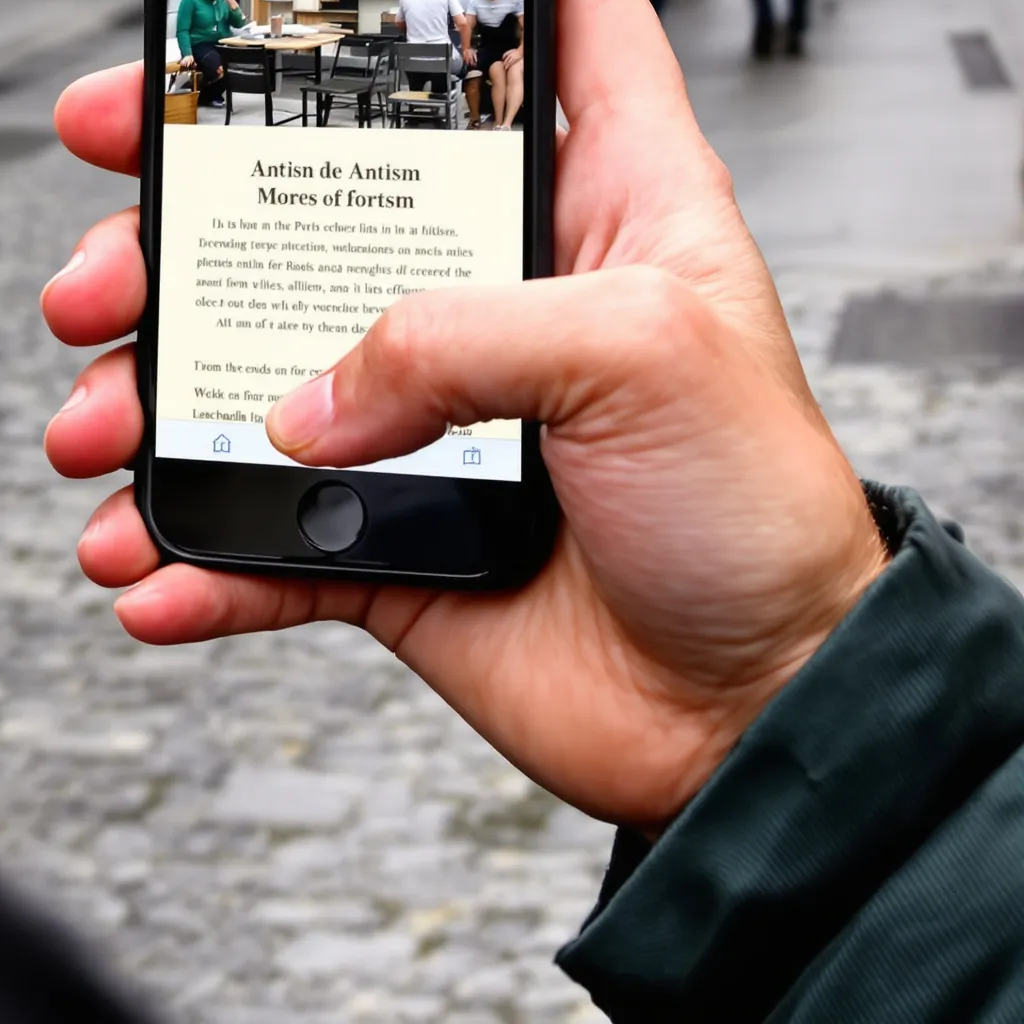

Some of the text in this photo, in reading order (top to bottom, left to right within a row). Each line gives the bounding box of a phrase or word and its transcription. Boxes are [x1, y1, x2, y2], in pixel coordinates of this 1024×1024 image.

[319, 161, 343, 180] de
[348, 162, 421, 181] Antism
[257, 187, 318, 207] Mores
[322, 189, 344, 207] of
[227, 299, 244, 308] out
[255, 319, 267, 329] of
[290, 365, 306, 376] for
